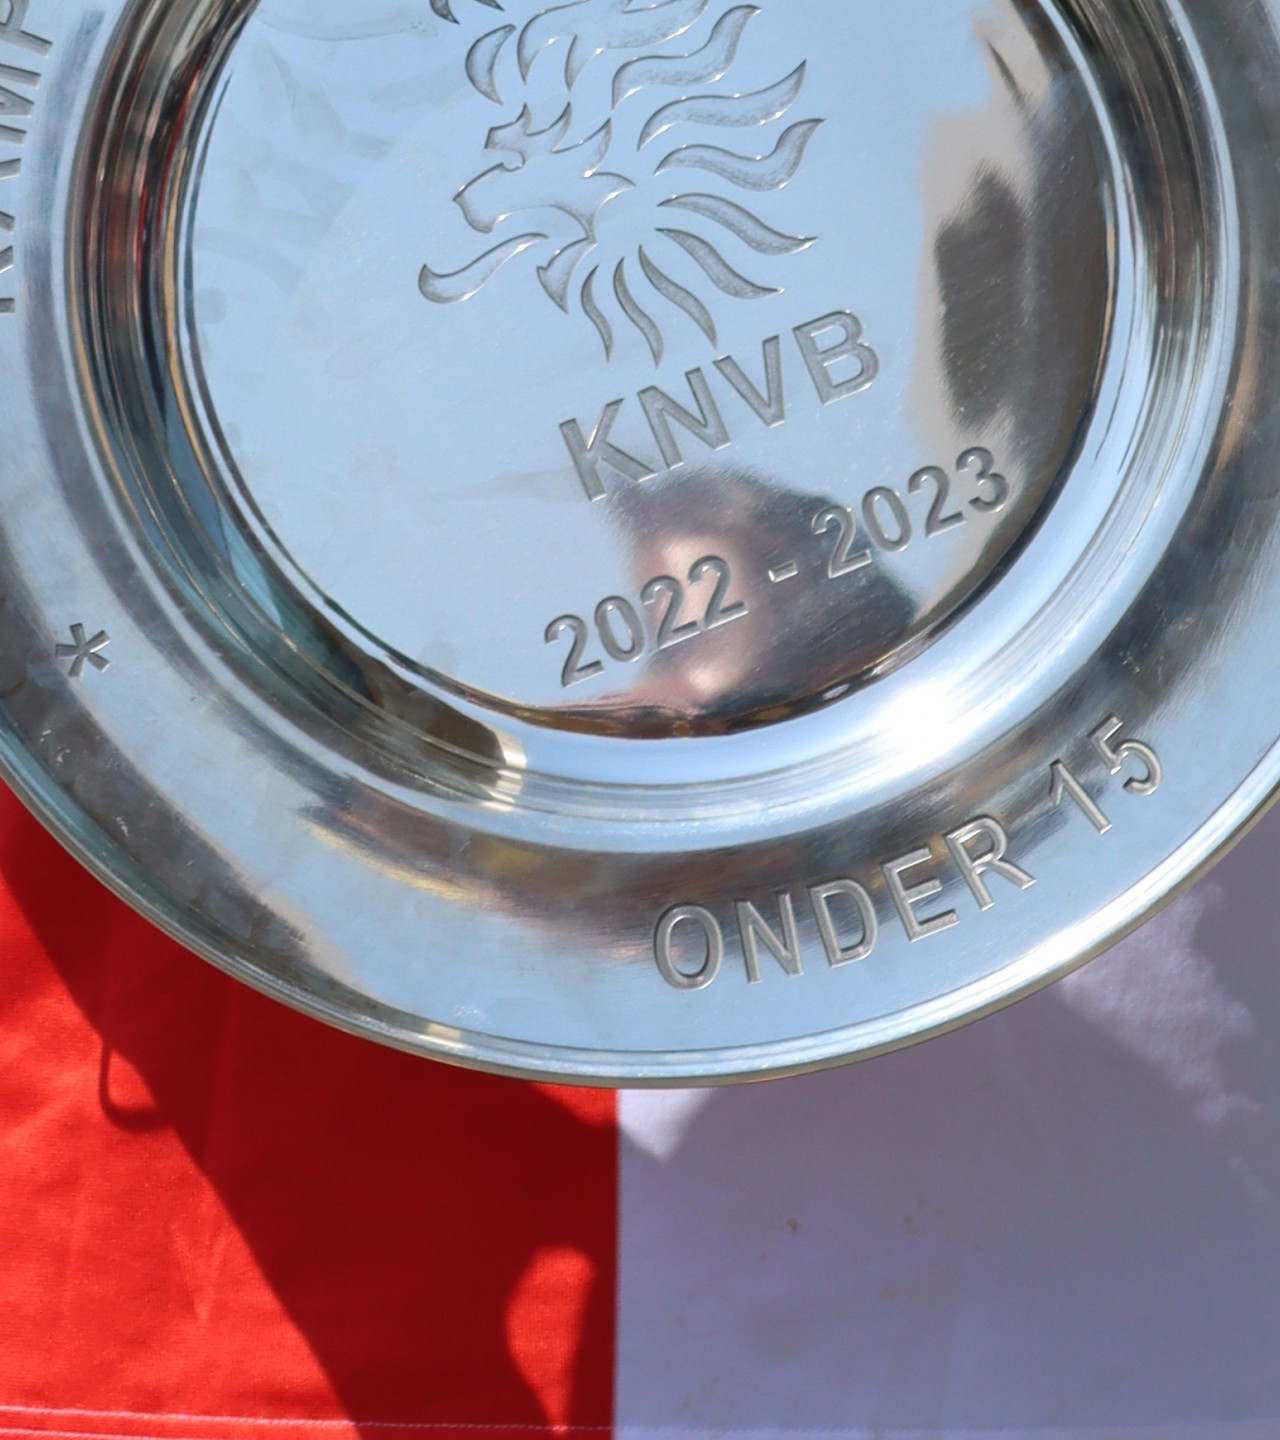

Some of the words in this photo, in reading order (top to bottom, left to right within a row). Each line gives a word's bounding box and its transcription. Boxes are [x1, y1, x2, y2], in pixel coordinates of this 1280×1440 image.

[558, 308, 880, 502] KNVB
[543, 555, 748, 688] 2022
[812, 446, 1010, 580] 2023
[653, 814, 1037, 991] ONDER
[1048, 713, 1163, 835] 15
